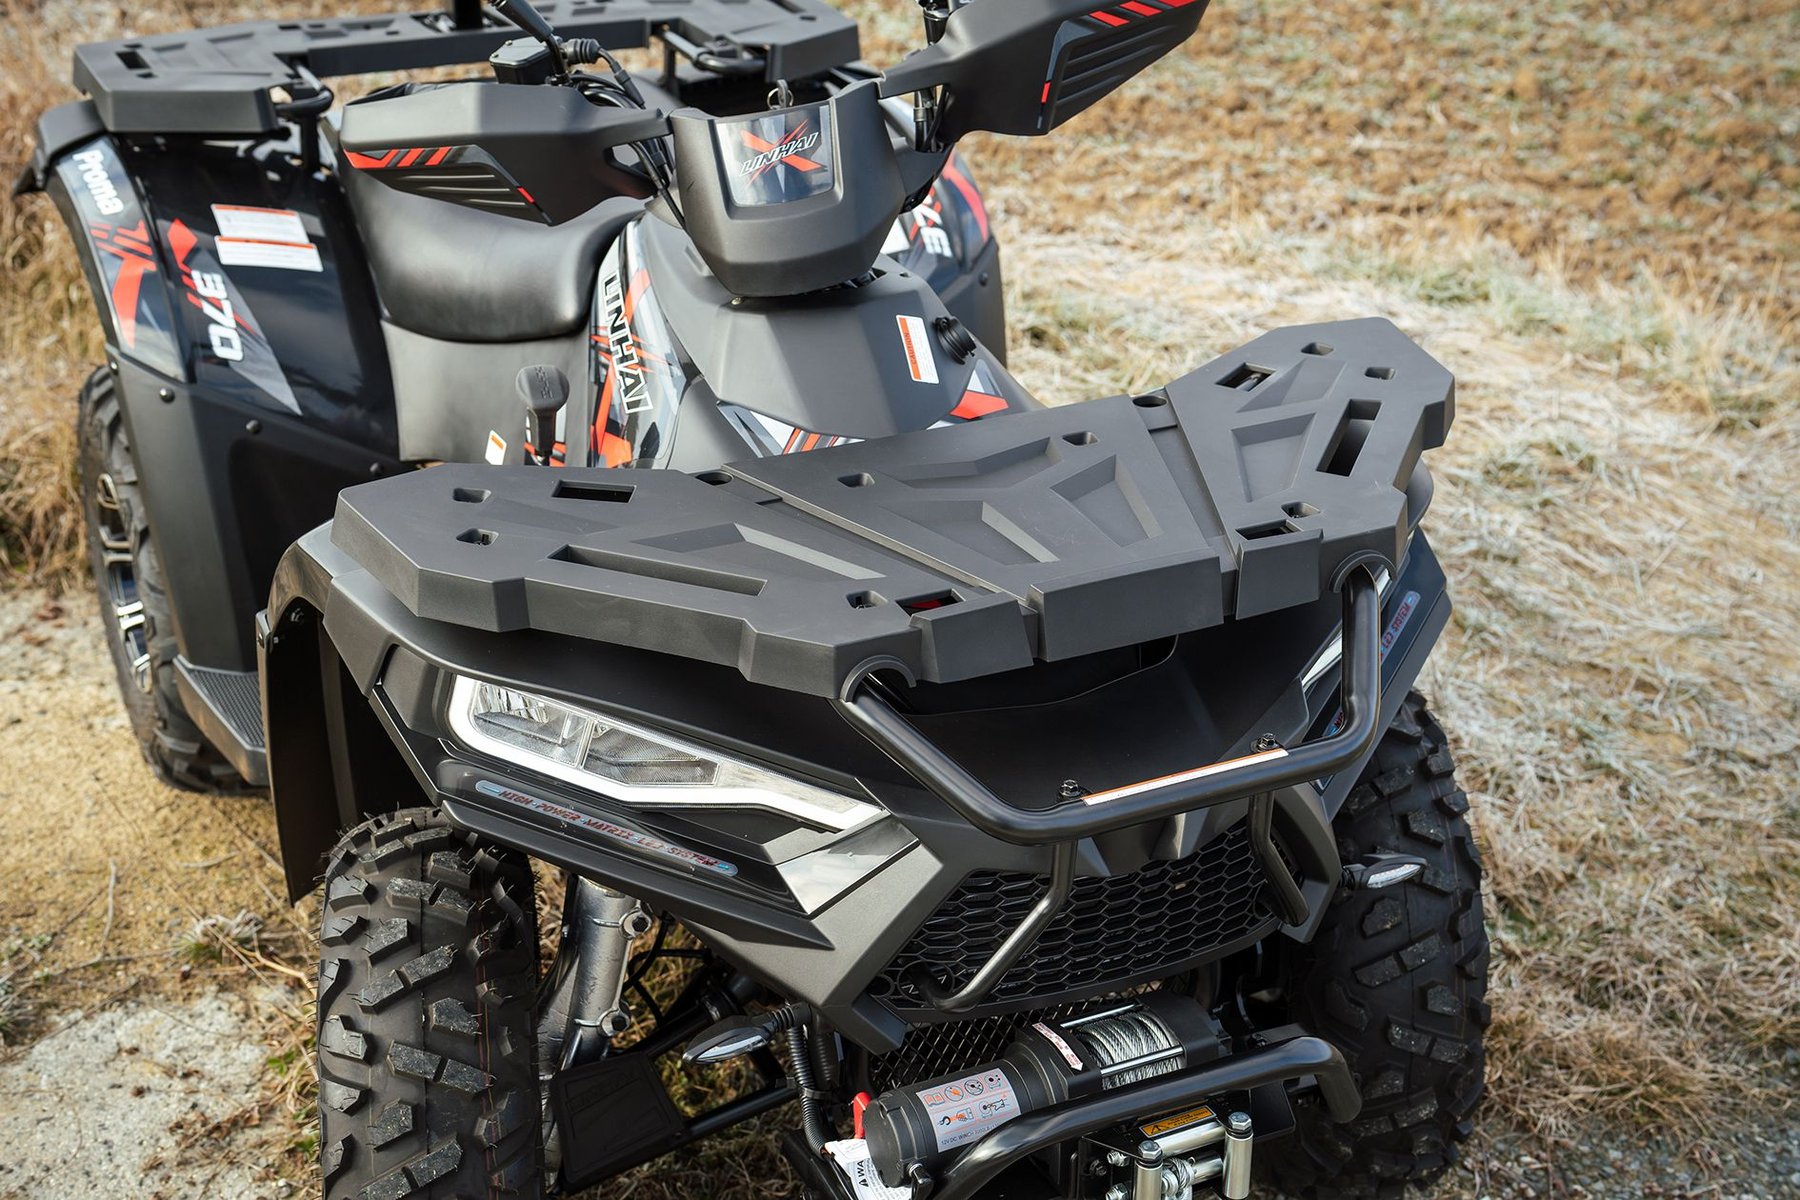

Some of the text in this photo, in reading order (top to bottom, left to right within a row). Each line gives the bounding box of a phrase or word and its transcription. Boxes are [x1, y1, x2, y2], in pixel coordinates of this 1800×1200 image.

[740, 131, 819, 177] LINHAI
[191, 269, 244, 361] 370
[602, 270, 654, 414] LINHAI
[904, 332, 917, 365] CAUTION
[498, 790, 533, 806] HIGH
[536, 802, 581, 821] POWER
[583, 818, 634, 840] MATRIX
[667, 847, 720, 867] SYSTEM
